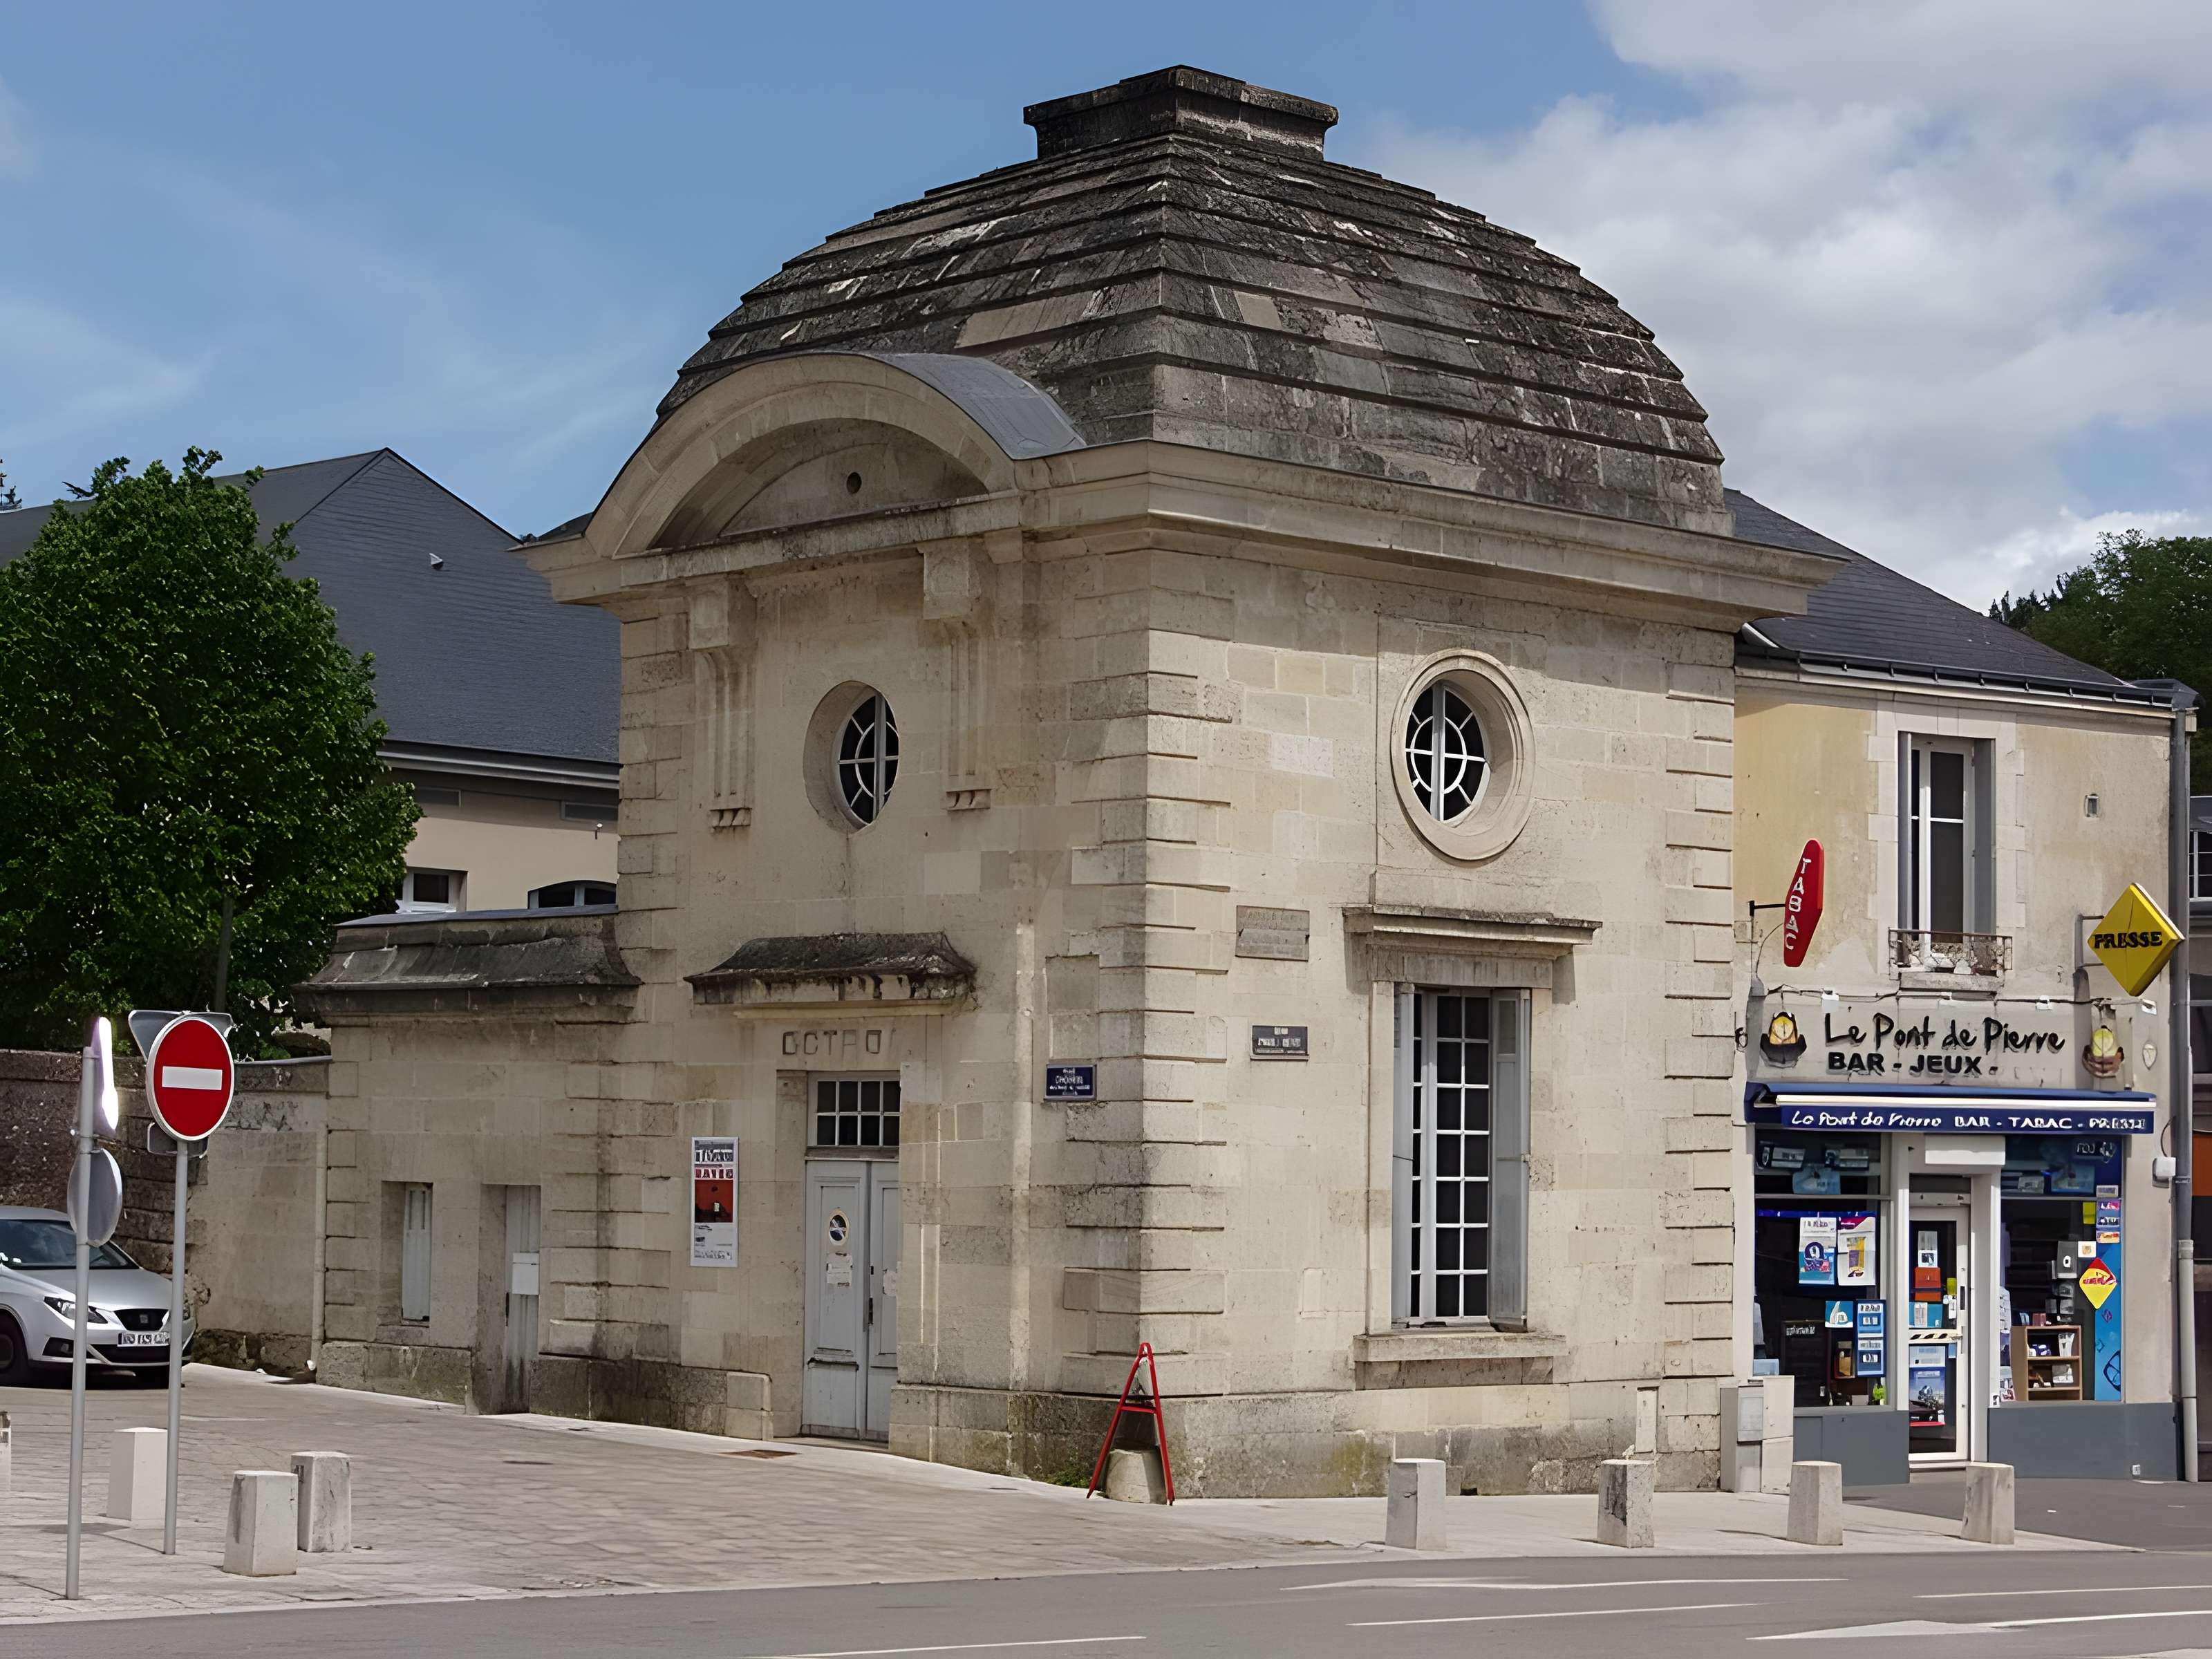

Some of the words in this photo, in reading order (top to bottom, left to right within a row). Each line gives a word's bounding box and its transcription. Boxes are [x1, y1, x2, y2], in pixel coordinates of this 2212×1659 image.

[1785, 857, 1812, 950] TABAC
[2094, 931, 2163, 949] PRESSE
[1824, 1013, 1867, 1045] Le
[1873, 1012, 1936, 1050] Pont
[1941, 1020, 1978, 1050] de
[1983, 1016, 2065, 1055] Pierre
[1827, 1051, 1886, 1075] BAR
[1909, 1054, 1983, 1076] JEUX
[1818, 1111, 1858, 1126] Pont
[1954, 1116, 1991, 1127] BAR
[2007, 1116, 2072, 1129] TABAC
